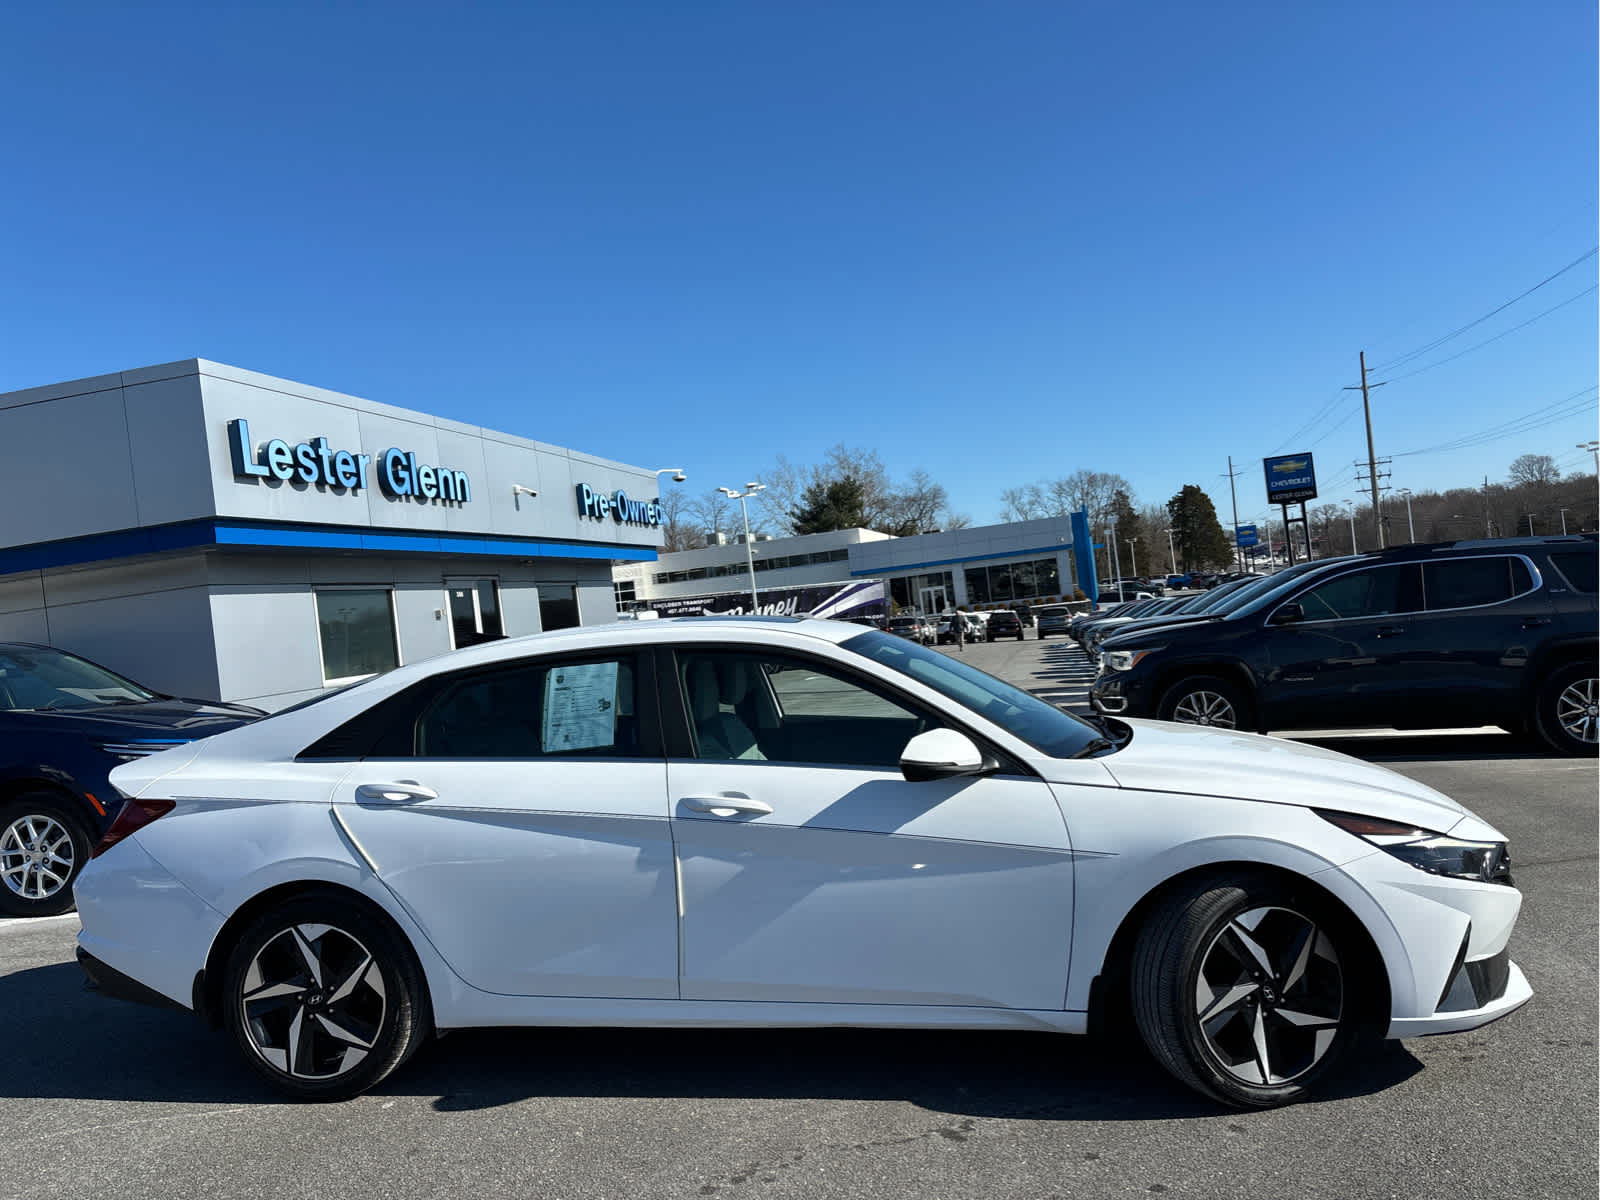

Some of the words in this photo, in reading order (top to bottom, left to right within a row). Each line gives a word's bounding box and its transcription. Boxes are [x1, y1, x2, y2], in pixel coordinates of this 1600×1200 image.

[229, 418, 371, 489] Lester
[376, 447, 471, 502] Glenn
[576, 483, 665, 525] Pre-Owned
